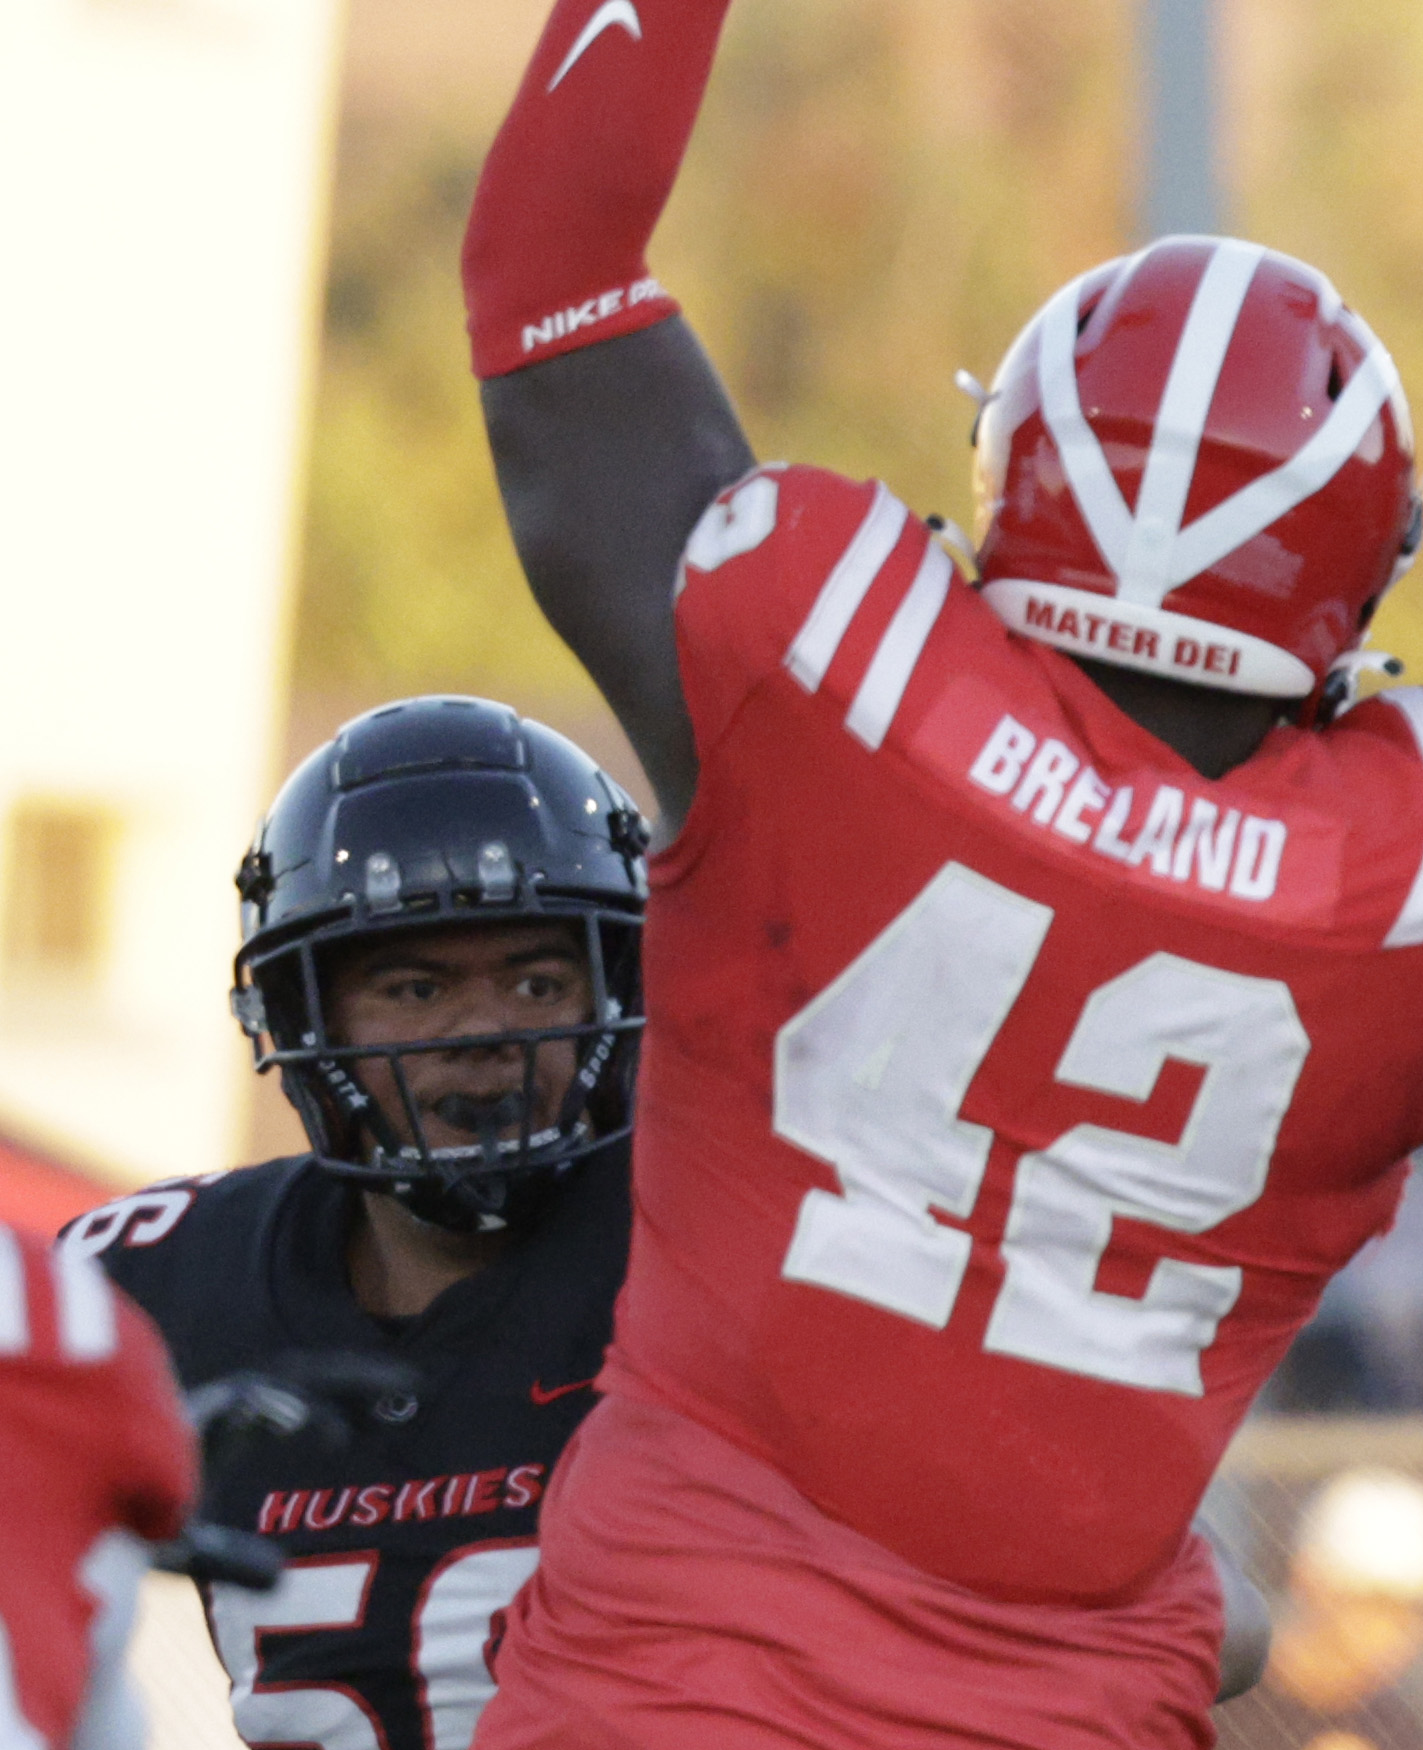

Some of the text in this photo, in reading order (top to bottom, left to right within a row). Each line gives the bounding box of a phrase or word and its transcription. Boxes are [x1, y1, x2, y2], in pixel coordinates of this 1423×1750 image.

[519, 286, 625, 354] NIKE
[1025, 596, 1242, 677] MATER DEI
[966, 712, 1288, 902] BRELAND
[772, 859, 1312, 1399] 42
[256, 1462, 547, 1535] HUSKIES
